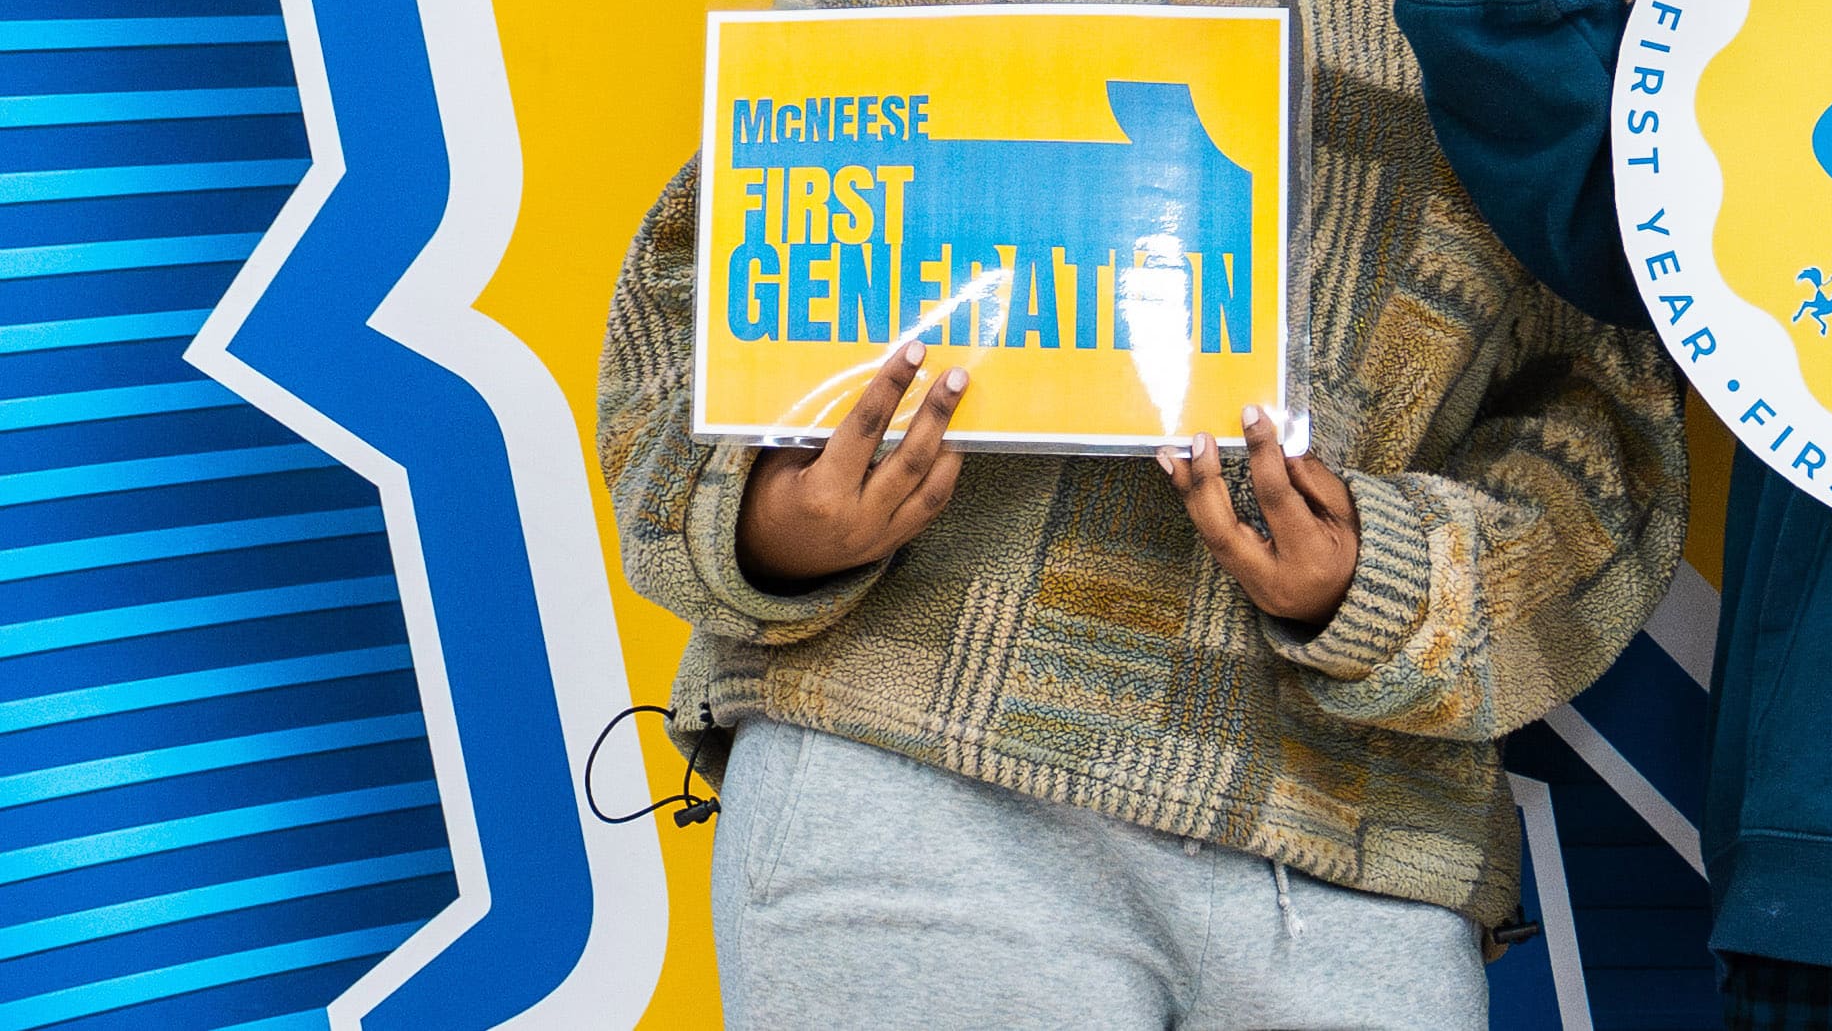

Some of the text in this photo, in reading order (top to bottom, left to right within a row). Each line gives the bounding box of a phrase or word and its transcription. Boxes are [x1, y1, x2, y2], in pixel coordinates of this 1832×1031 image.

[732, 94, 929, 143] McNEESE
[730, 165, 914, 245] FIRST
[1627, 0, 1717, 363] FIRST YEAR
